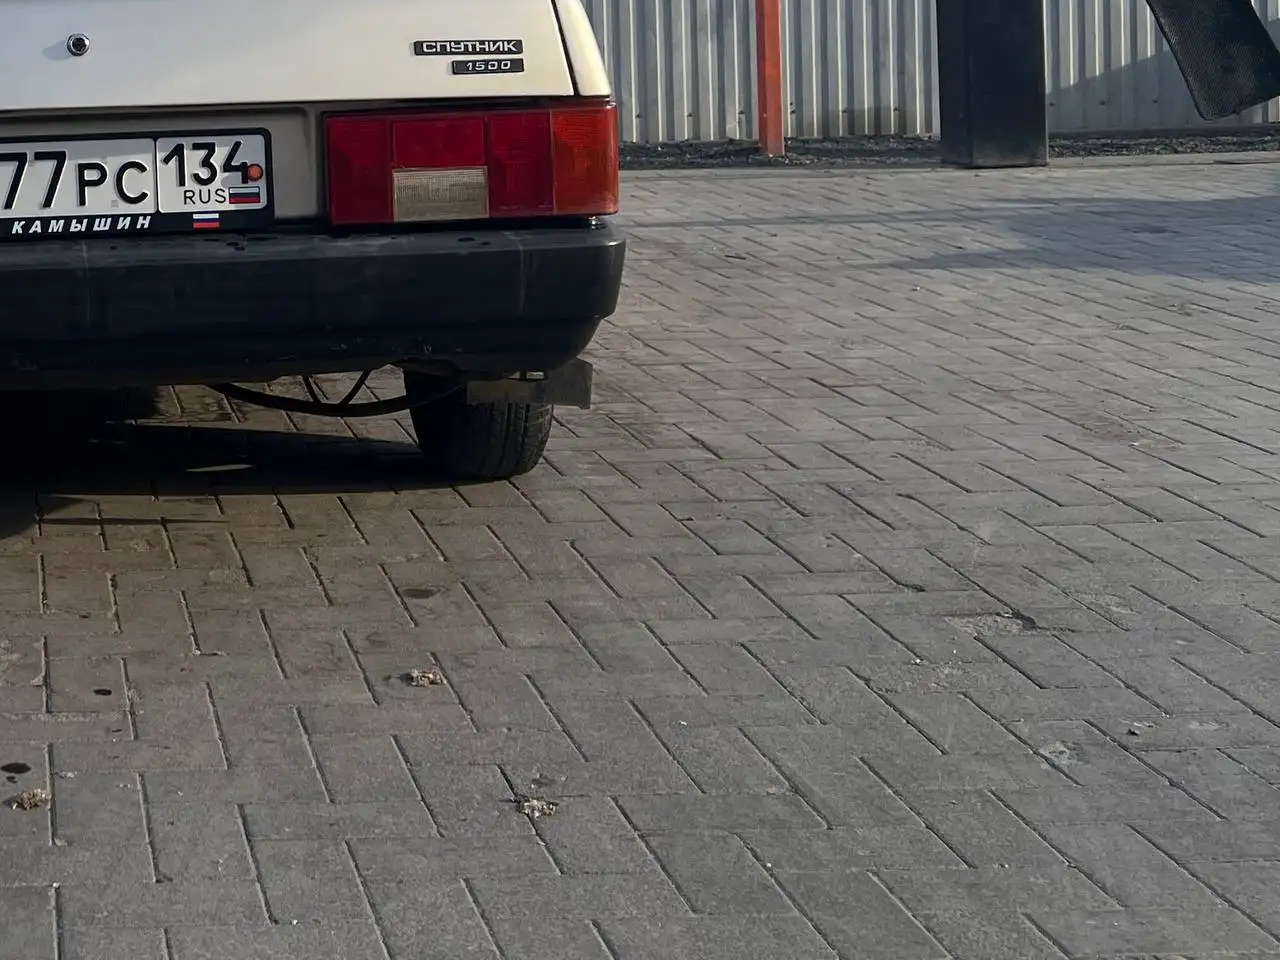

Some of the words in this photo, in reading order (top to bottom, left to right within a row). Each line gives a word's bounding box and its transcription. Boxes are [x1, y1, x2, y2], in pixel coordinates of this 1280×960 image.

[422, 41, 518, 52] СПУТНИК
[466, 60, 511, 71] 1500
[163, 141, 250, 188] 134
[184, 188, 227, 205] RUS
[11, 215, 152, 235] КАМЫШИН
